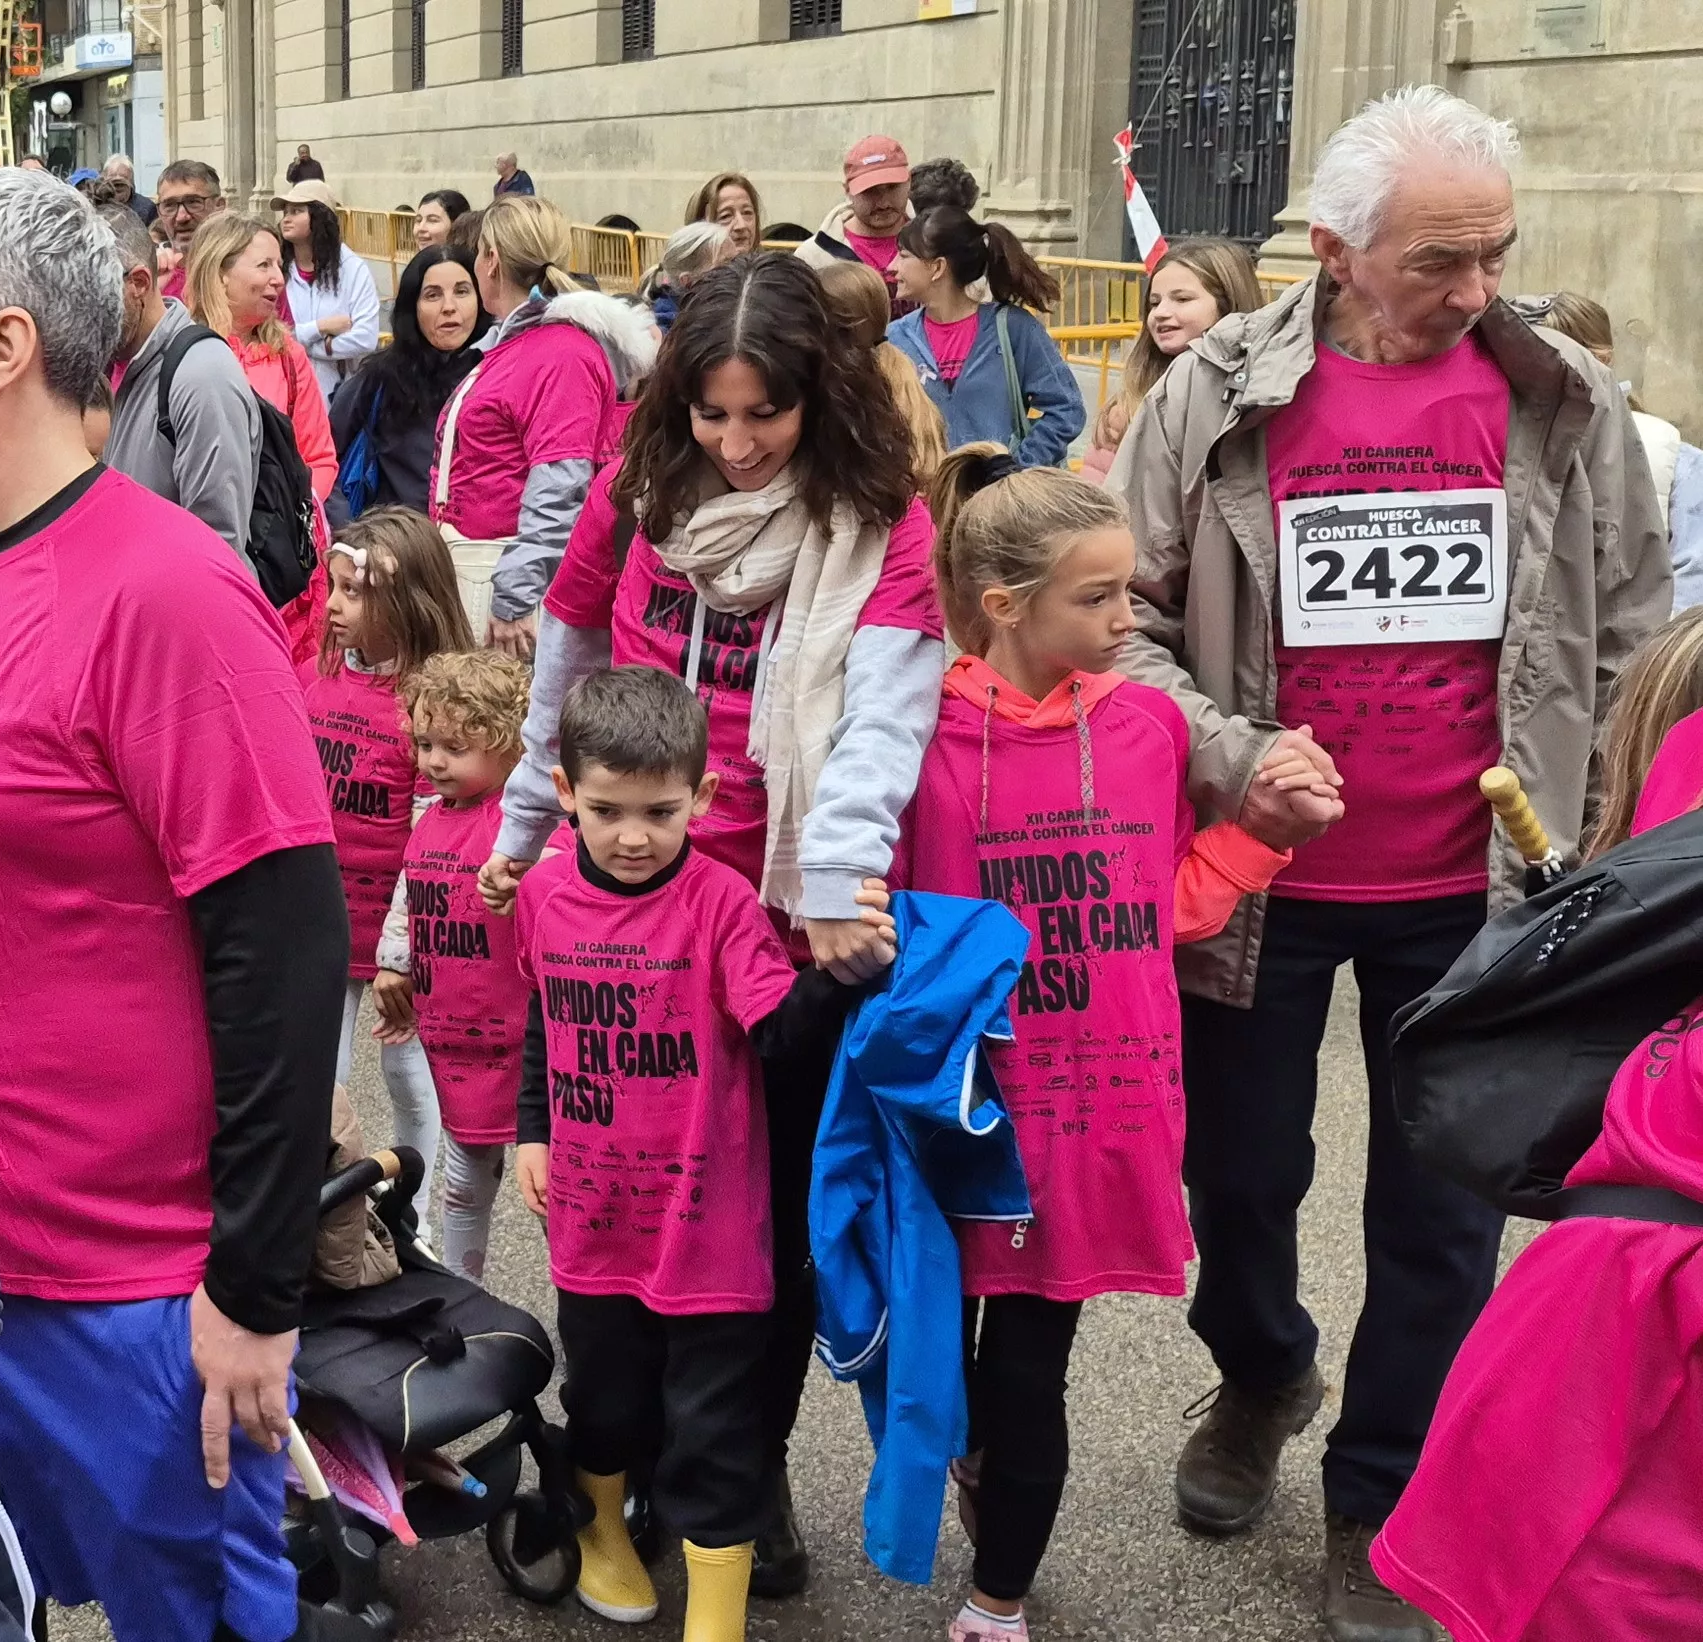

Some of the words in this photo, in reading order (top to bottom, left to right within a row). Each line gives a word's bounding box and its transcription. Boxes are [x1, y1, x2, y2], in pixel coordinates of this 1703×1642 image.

[1342, 447, 1361, 459] XII
[1365, 446, 1434, 459] CARRERA
[1288, 464, 1343, 479] HUESCA
[1347, 461, 1406, 475] CONTRA
[1412, 462, 1428, 474] EL
[1432, 460, 1483, 477] CÁNCER
[1306, 523, 1382, 541] CONTRA
[1388, 524, 1408, 537] EL
[1412, 517, 1482, 534] CÁNCER
[1368, 509, 1422, 522] HUESCA
[1304, 542, 1486, 603] 2422
[326, 720, 353, 733] CONTRA
[354, 727, 364, 736] EL
[332, 778, 390, 818] CADA
[975, 832, 1029, 846] HUESCA
[1032, 824, 1090, 841] CONTRA
[1091, 823, 1108, 836] EL
[1111, 820, 1155, 835] CÁNCER
[1025, 813, 1043, 826] XII
[1047, 808, 1111, 824] CARRRA
[979, 851, 1111, 904] UNIDOS
[434, 920, 490, 960] CADA
[1039, 905, 1083, 956] EN
[542, 951, 573, 966] HUESCA
[576, 957, 623, 969] CONTRA
[626, 958, 640, 970] EL
[574, 942, 587, 952] XII
[589, 943, 646, 955] CARRERA
[1009, 954, 1091, 1016] ASO
[545, 975, 636, 1029] UNIDOS
[577, 1028, 611, 1075] EN
[616, 1031, 698, 1077] CADA
[551, 1067, 613, 1127] PASO
